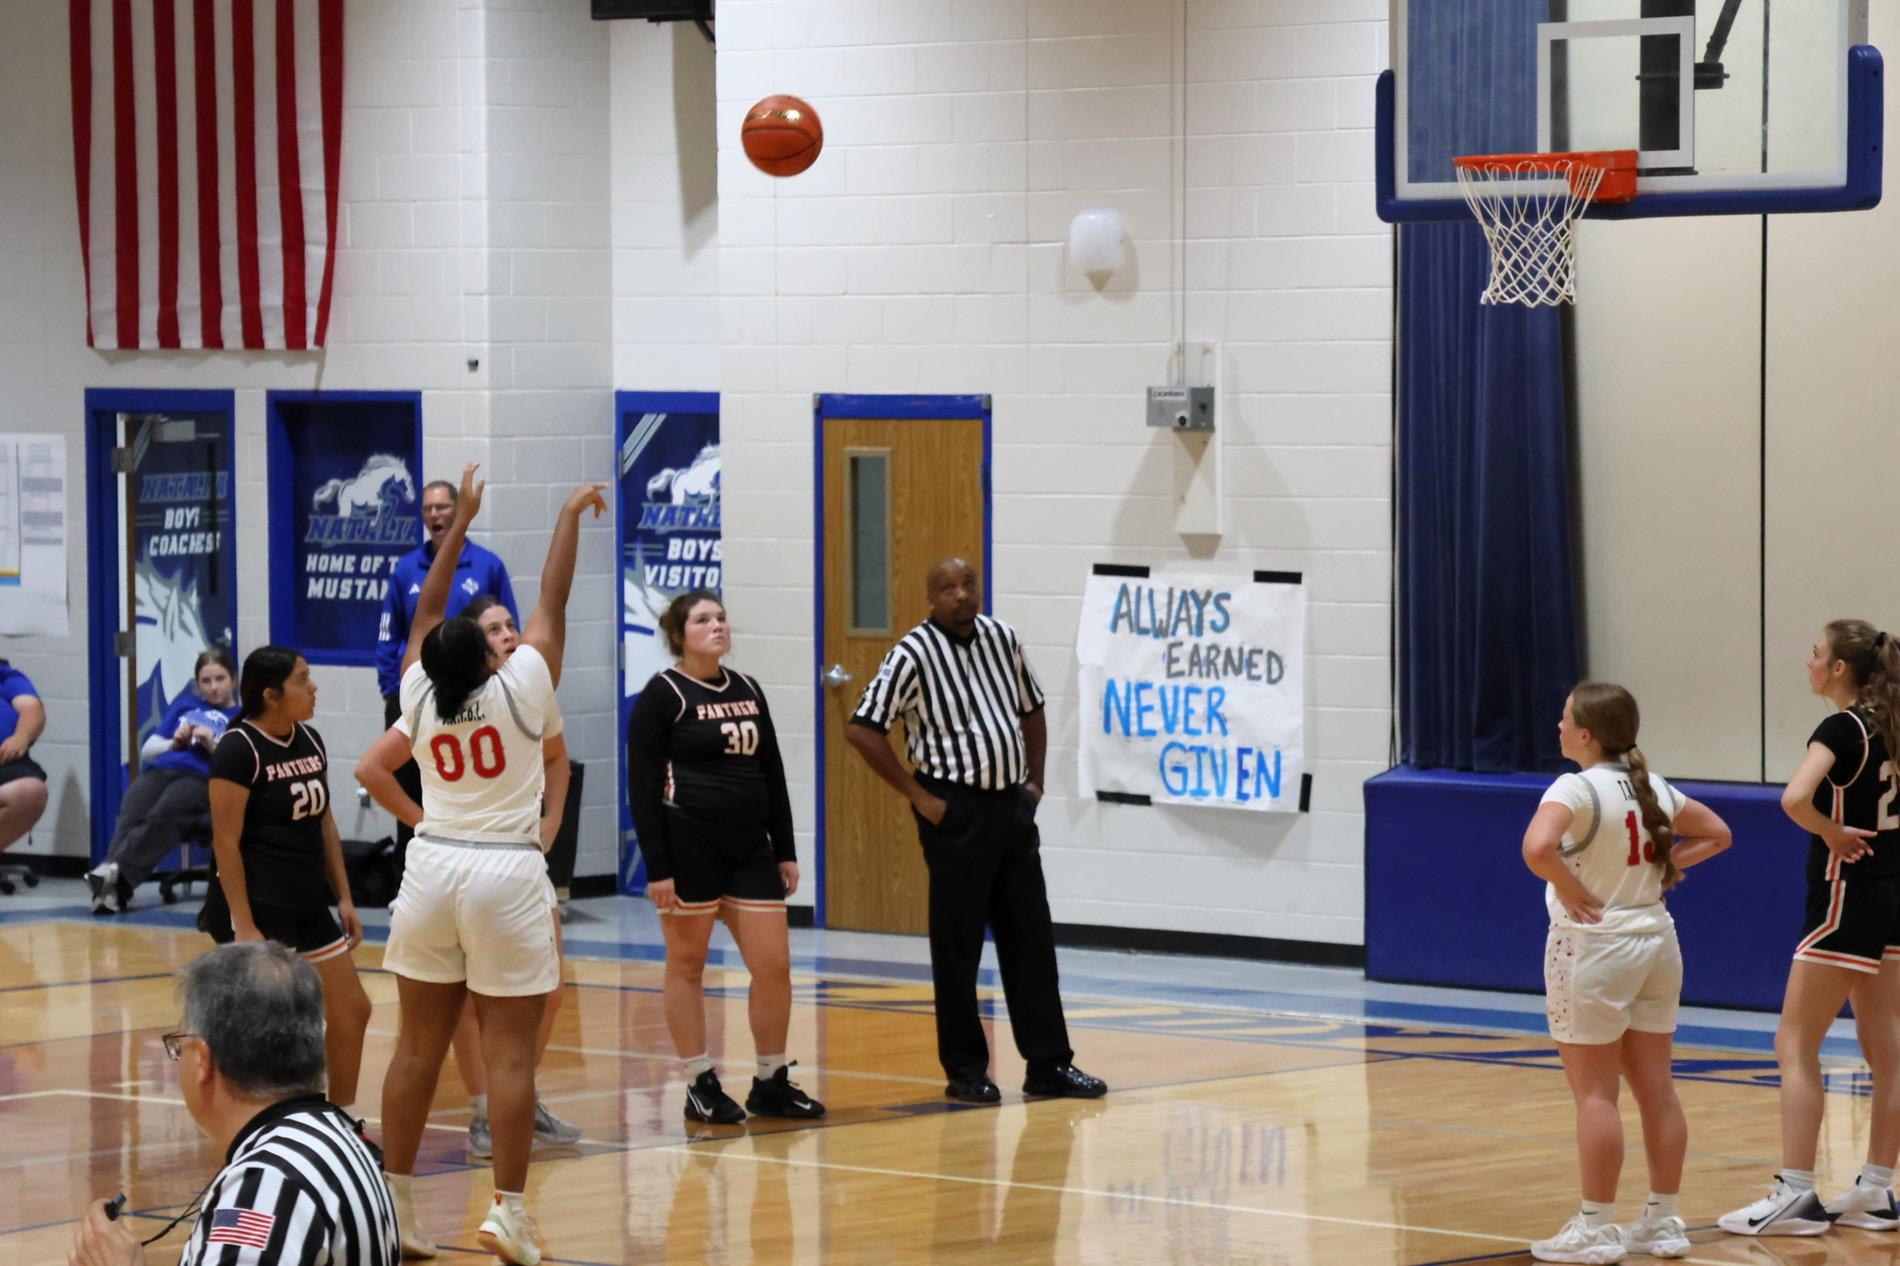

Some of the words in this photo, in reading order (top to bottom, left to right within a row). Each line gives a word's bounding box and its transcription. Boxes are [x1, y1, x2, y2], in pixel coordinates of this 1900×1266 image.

[306, 554, 356, 573] HOME
[361, 555, 384, 574] OF
[667, 538, 722, 561] BOYS
[1110, 583, 1231, 639] ALWAYS
[1165, 642, 1285, 684] EARNED
[1103, 679, 1228, 737] NEVER
[430, 725, 506, 782] 00
[721, 721, 759, 756] 30
[266, 755, 322, 782] PANTHERS
[1159, 741, 1282, 801] GIVEN
[290, 779, 326, 821] 20
